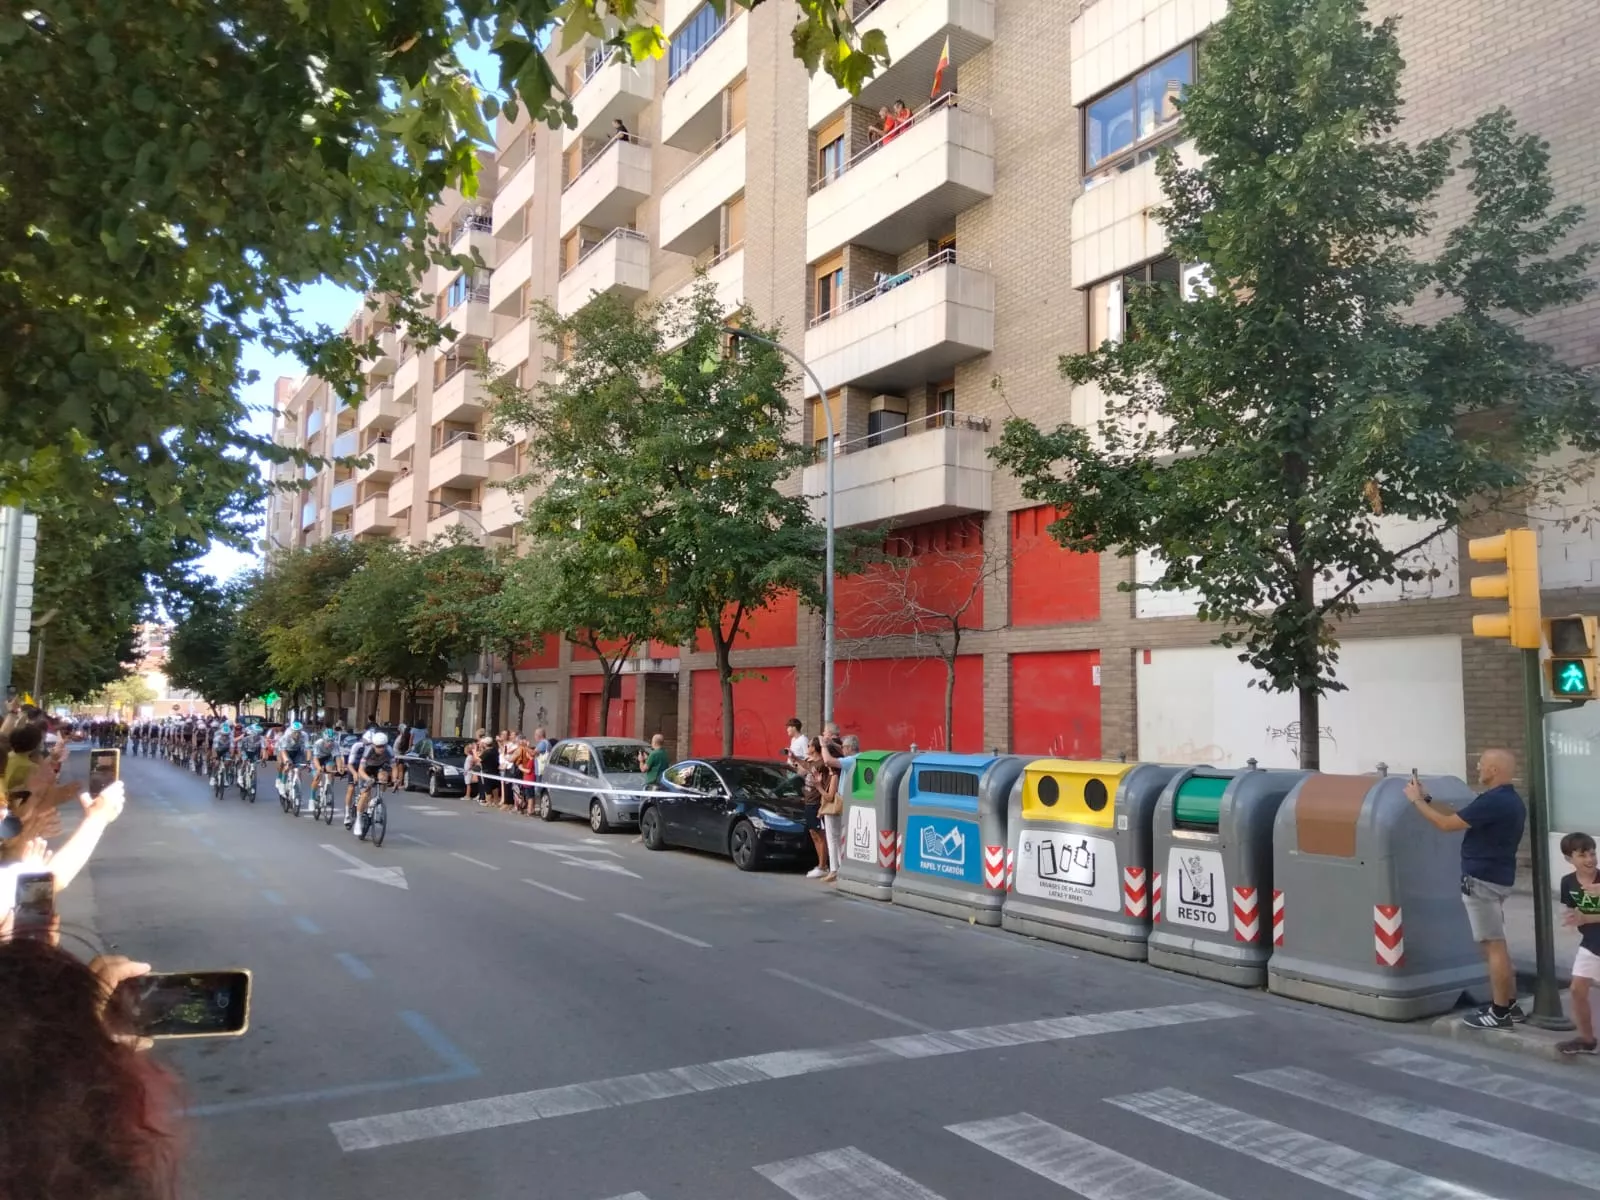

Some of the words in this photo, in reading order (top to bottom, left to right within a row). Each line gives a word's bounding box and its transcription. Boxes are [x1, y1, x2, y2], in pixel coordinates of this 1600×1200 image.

[920, 861, 936, 870] PAPEL
[1040, 881, 1061, 891] ENVASES
[1048, 890, 1063, 898] LATAS
[1178, 906, 1216, 924] RESTO
